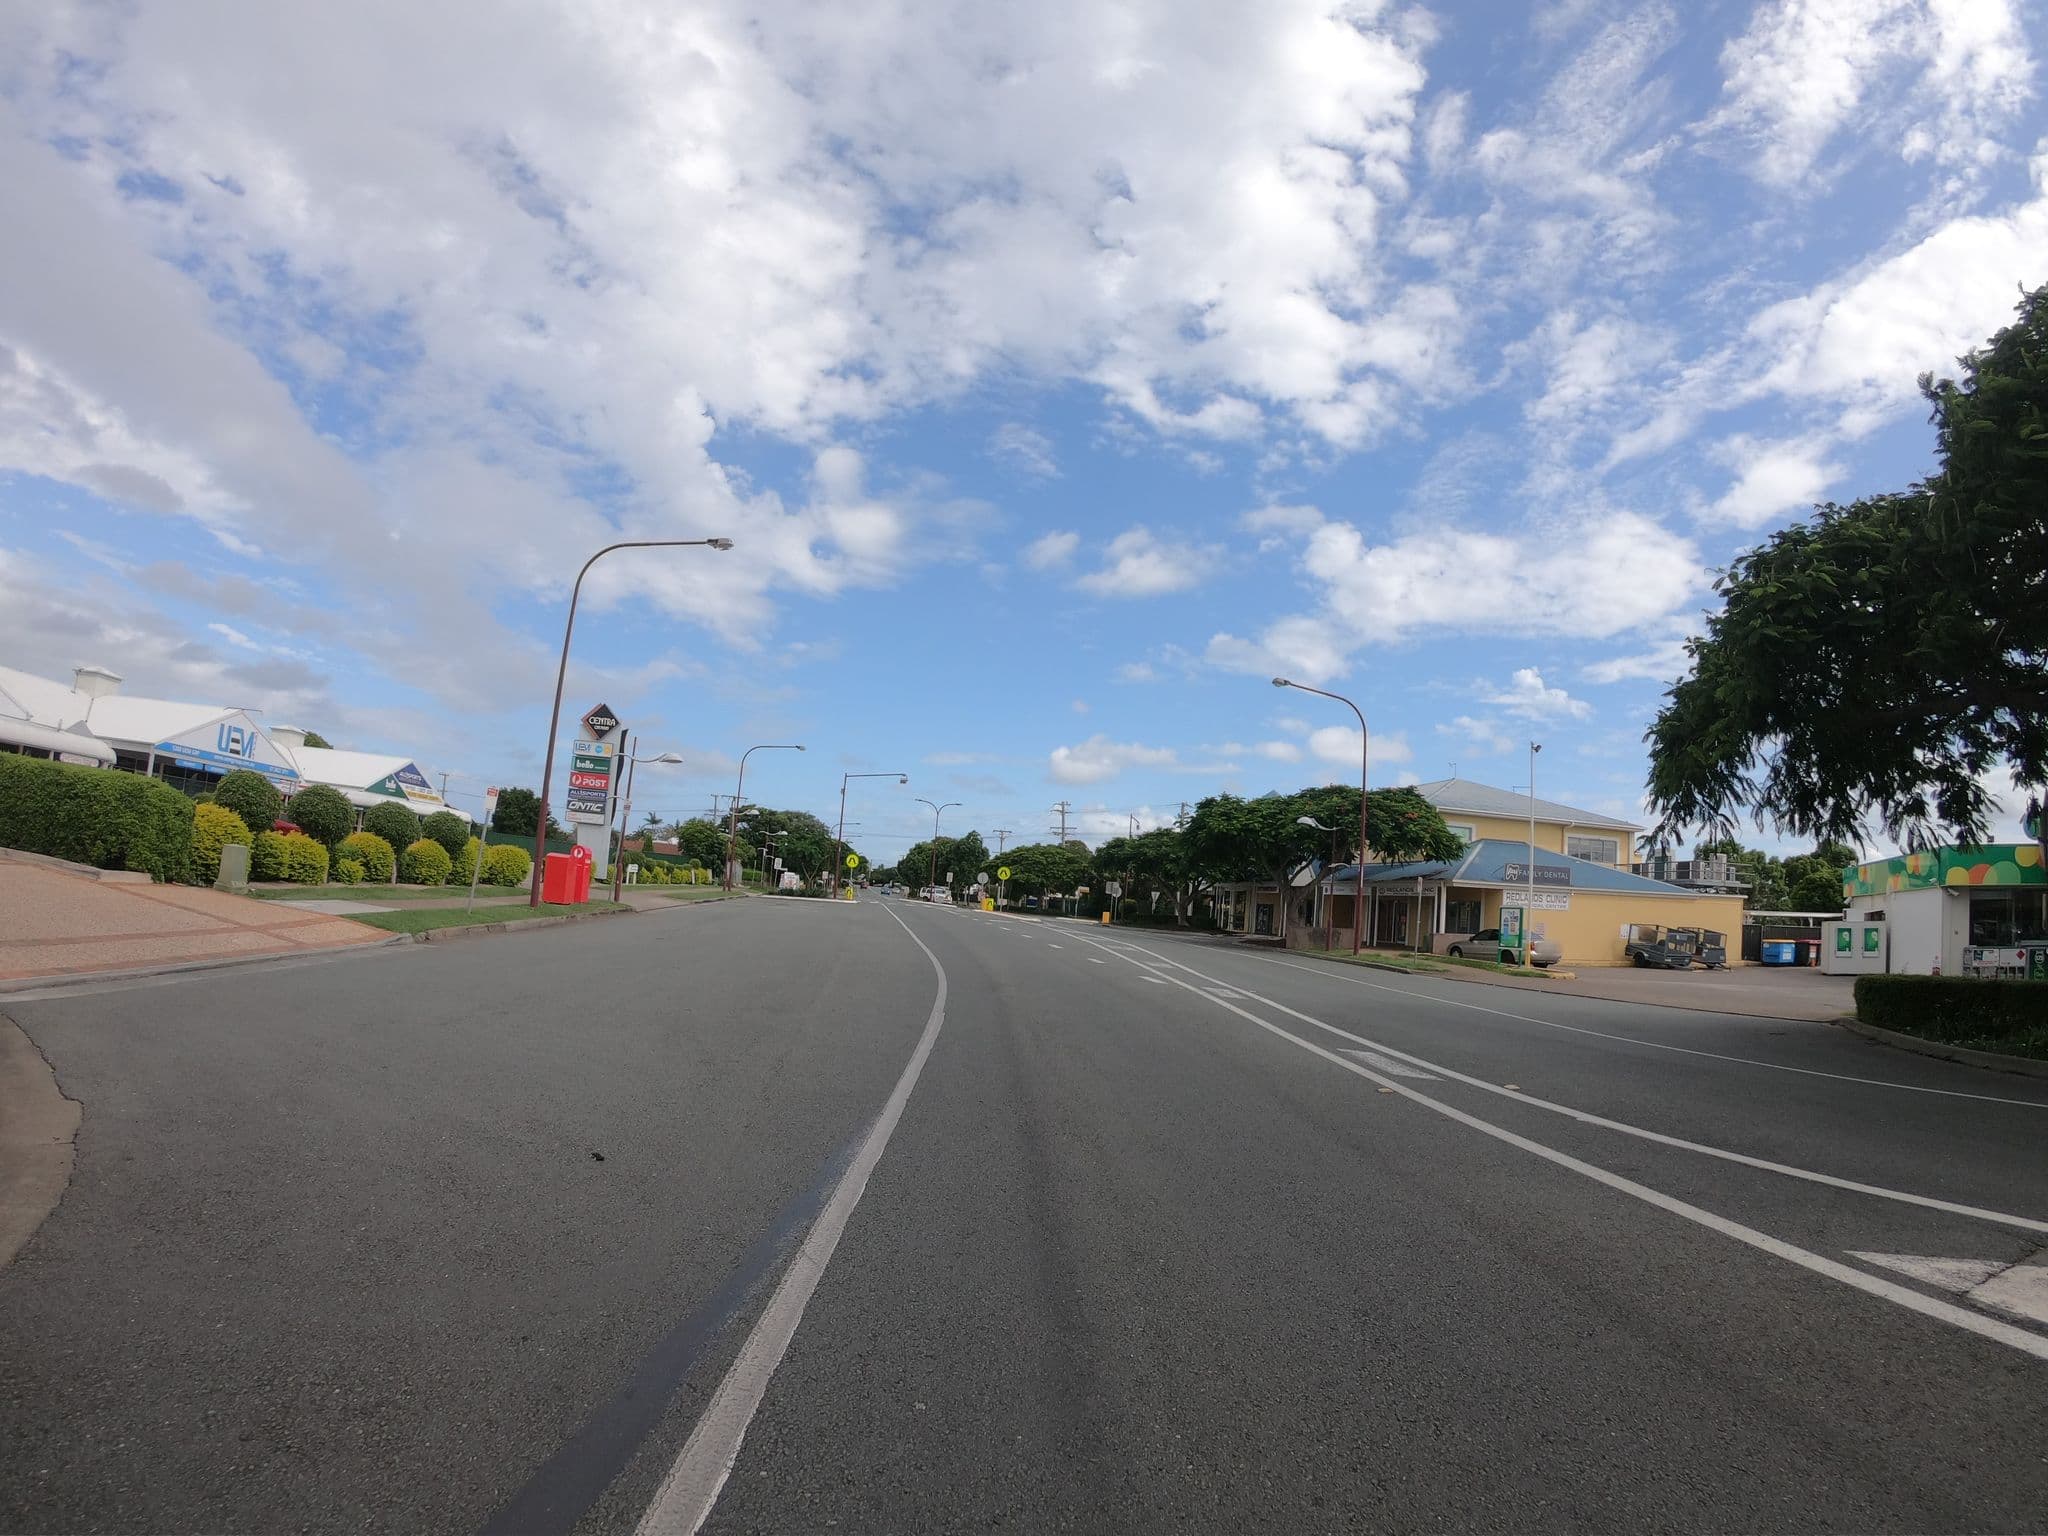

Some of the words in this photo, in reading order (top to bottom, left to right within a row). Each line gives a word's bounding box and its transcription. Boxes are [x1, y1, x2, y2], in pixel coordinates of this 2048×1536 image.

[582, 778, 607, 788] POST
[1543, 871, 1569, 880] DENTAL
[1506, 891, 1544, 904] REDLADS
[1545, 894, 1568, 904] CLINIC
